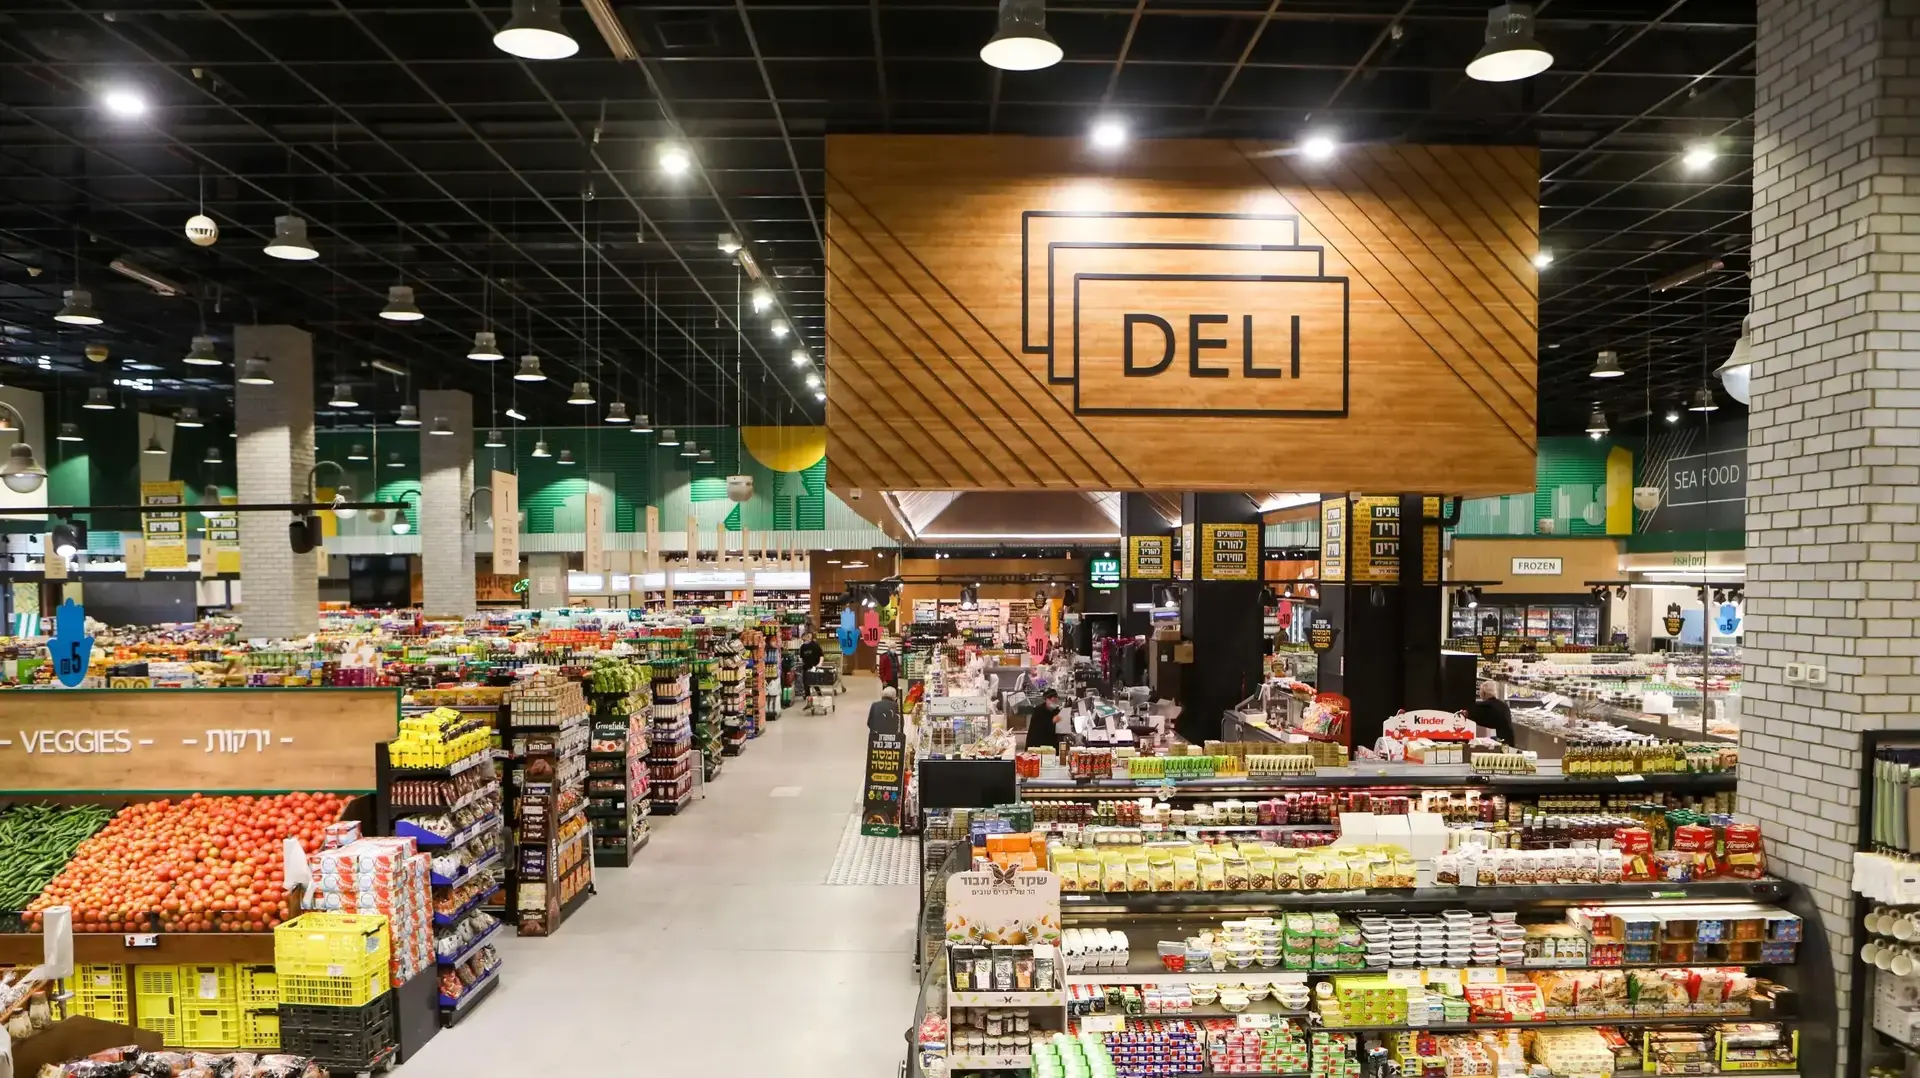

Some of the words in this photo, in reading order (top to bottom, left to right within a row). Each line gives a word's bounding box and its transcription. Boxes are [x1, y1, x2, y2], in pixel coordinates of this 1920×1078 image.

[1124, 314, 1300, 379] DELI
[1674, 470, 1698, 490] SEA
[1702, 465, 1740, 486] FOOD
[1217, 540, 1244, 550] להוריד
[1217, 553, 1243, 562] מחירים
[1094, 561, 1117, 575] עדן
[1518, 561, 1556, 570] FROZEN
[20, 729, 132, 753] VEGGIES
[205, 729, 271, 754] ירקות
[872, 750, 900, 761] חמסה
[871, 760, 899, 771] חמסה
[961, 876, 990, 886] תבור
[1019, 875, 1048, 887] שקד
